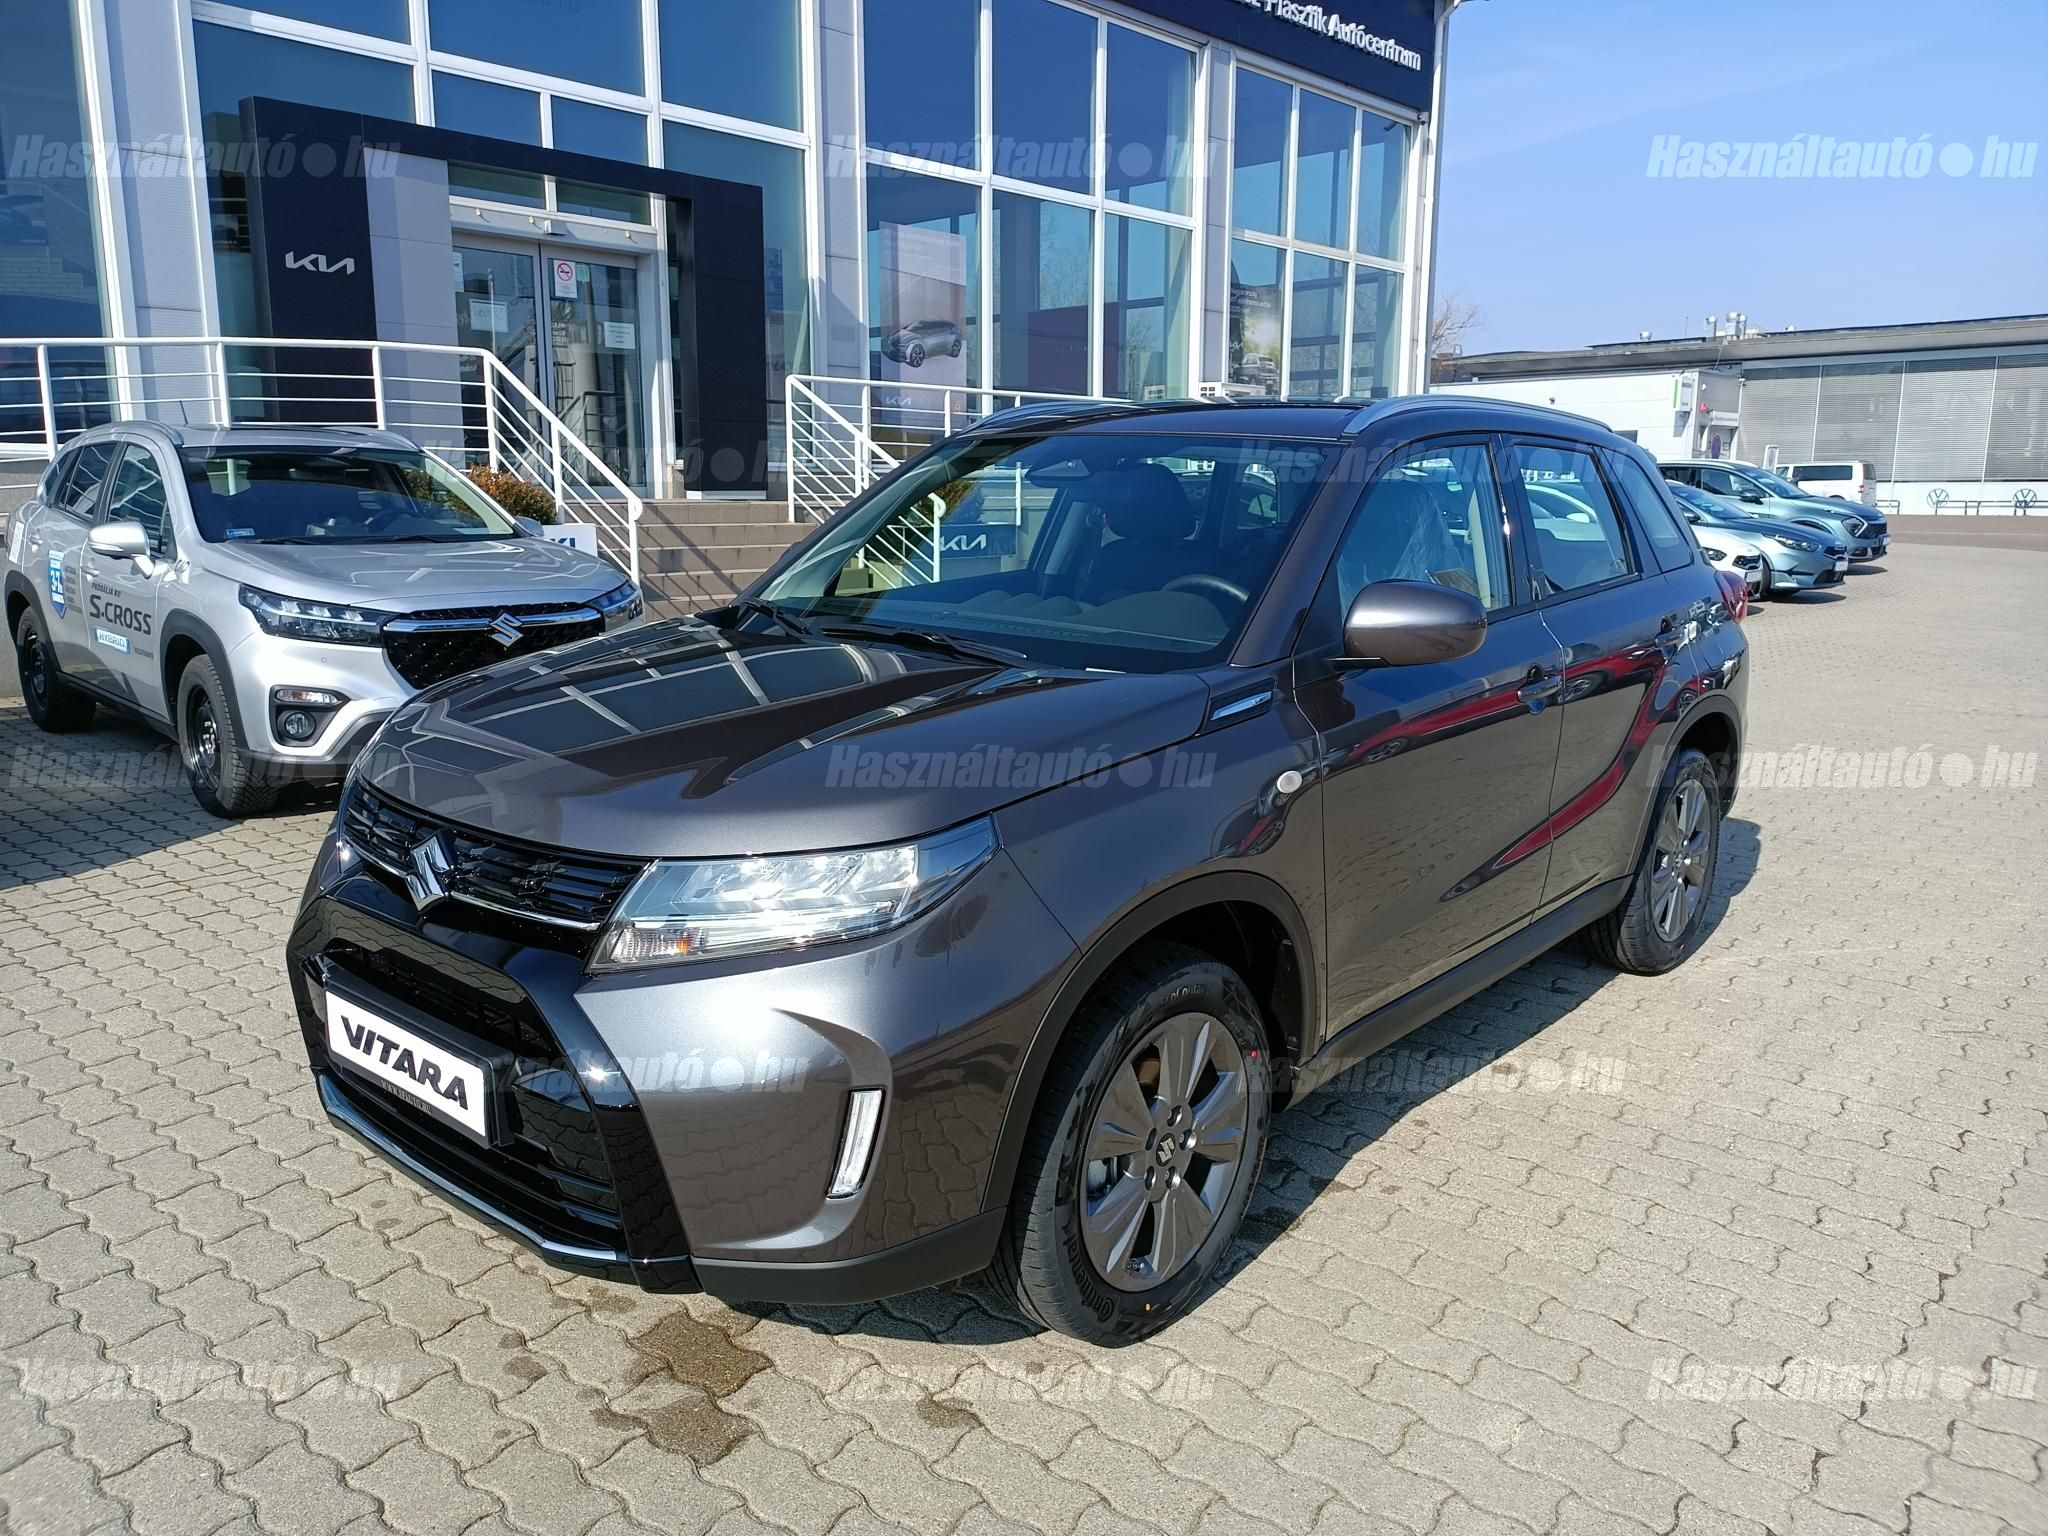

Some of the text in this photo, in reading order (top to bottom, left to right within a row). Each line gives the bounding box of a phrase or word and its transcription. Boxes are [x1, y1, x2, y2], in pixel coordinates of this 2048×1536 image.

[1328, 14, 1422, 71] Autócentrum
[98, 631, 126, 648] HYBRID
[341, 1015, 468, 1110] VITARA
